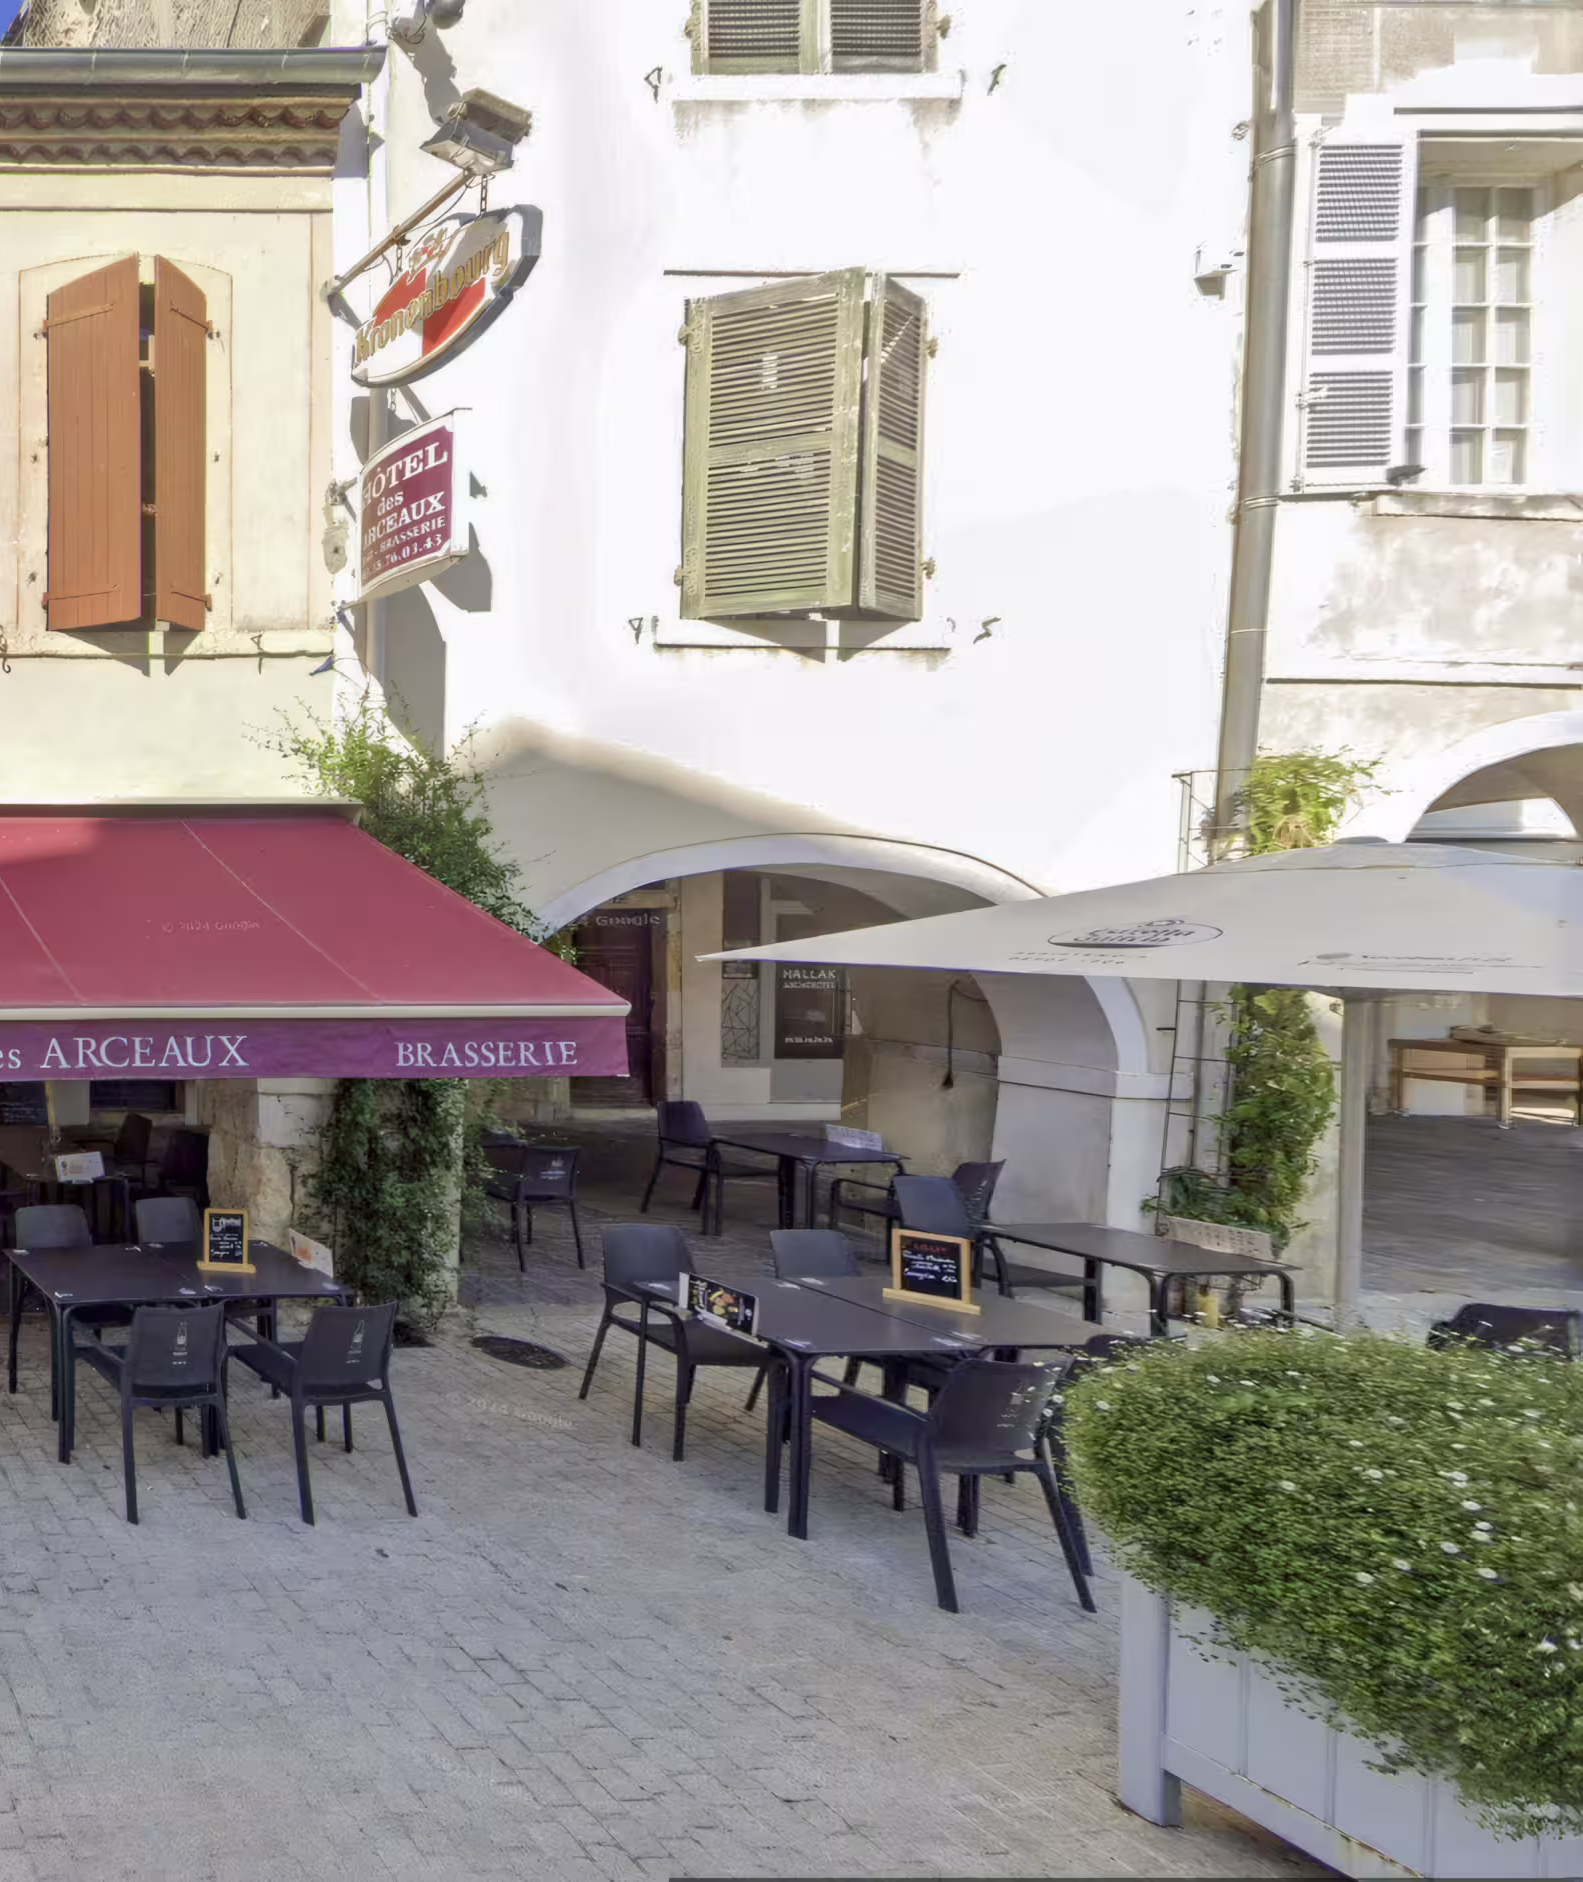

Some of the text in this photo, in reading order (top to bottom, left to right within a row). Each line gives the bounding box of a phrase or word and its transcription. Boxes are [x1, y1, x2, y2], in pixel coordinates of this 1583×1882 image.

[355, 231, 510, 366] Kronenbourg
[377, 491, 404, 517] des
[39, 1035, 250, 1069] ARCEAUX
[394, 1041, 578, 1067] BRASSERIE
